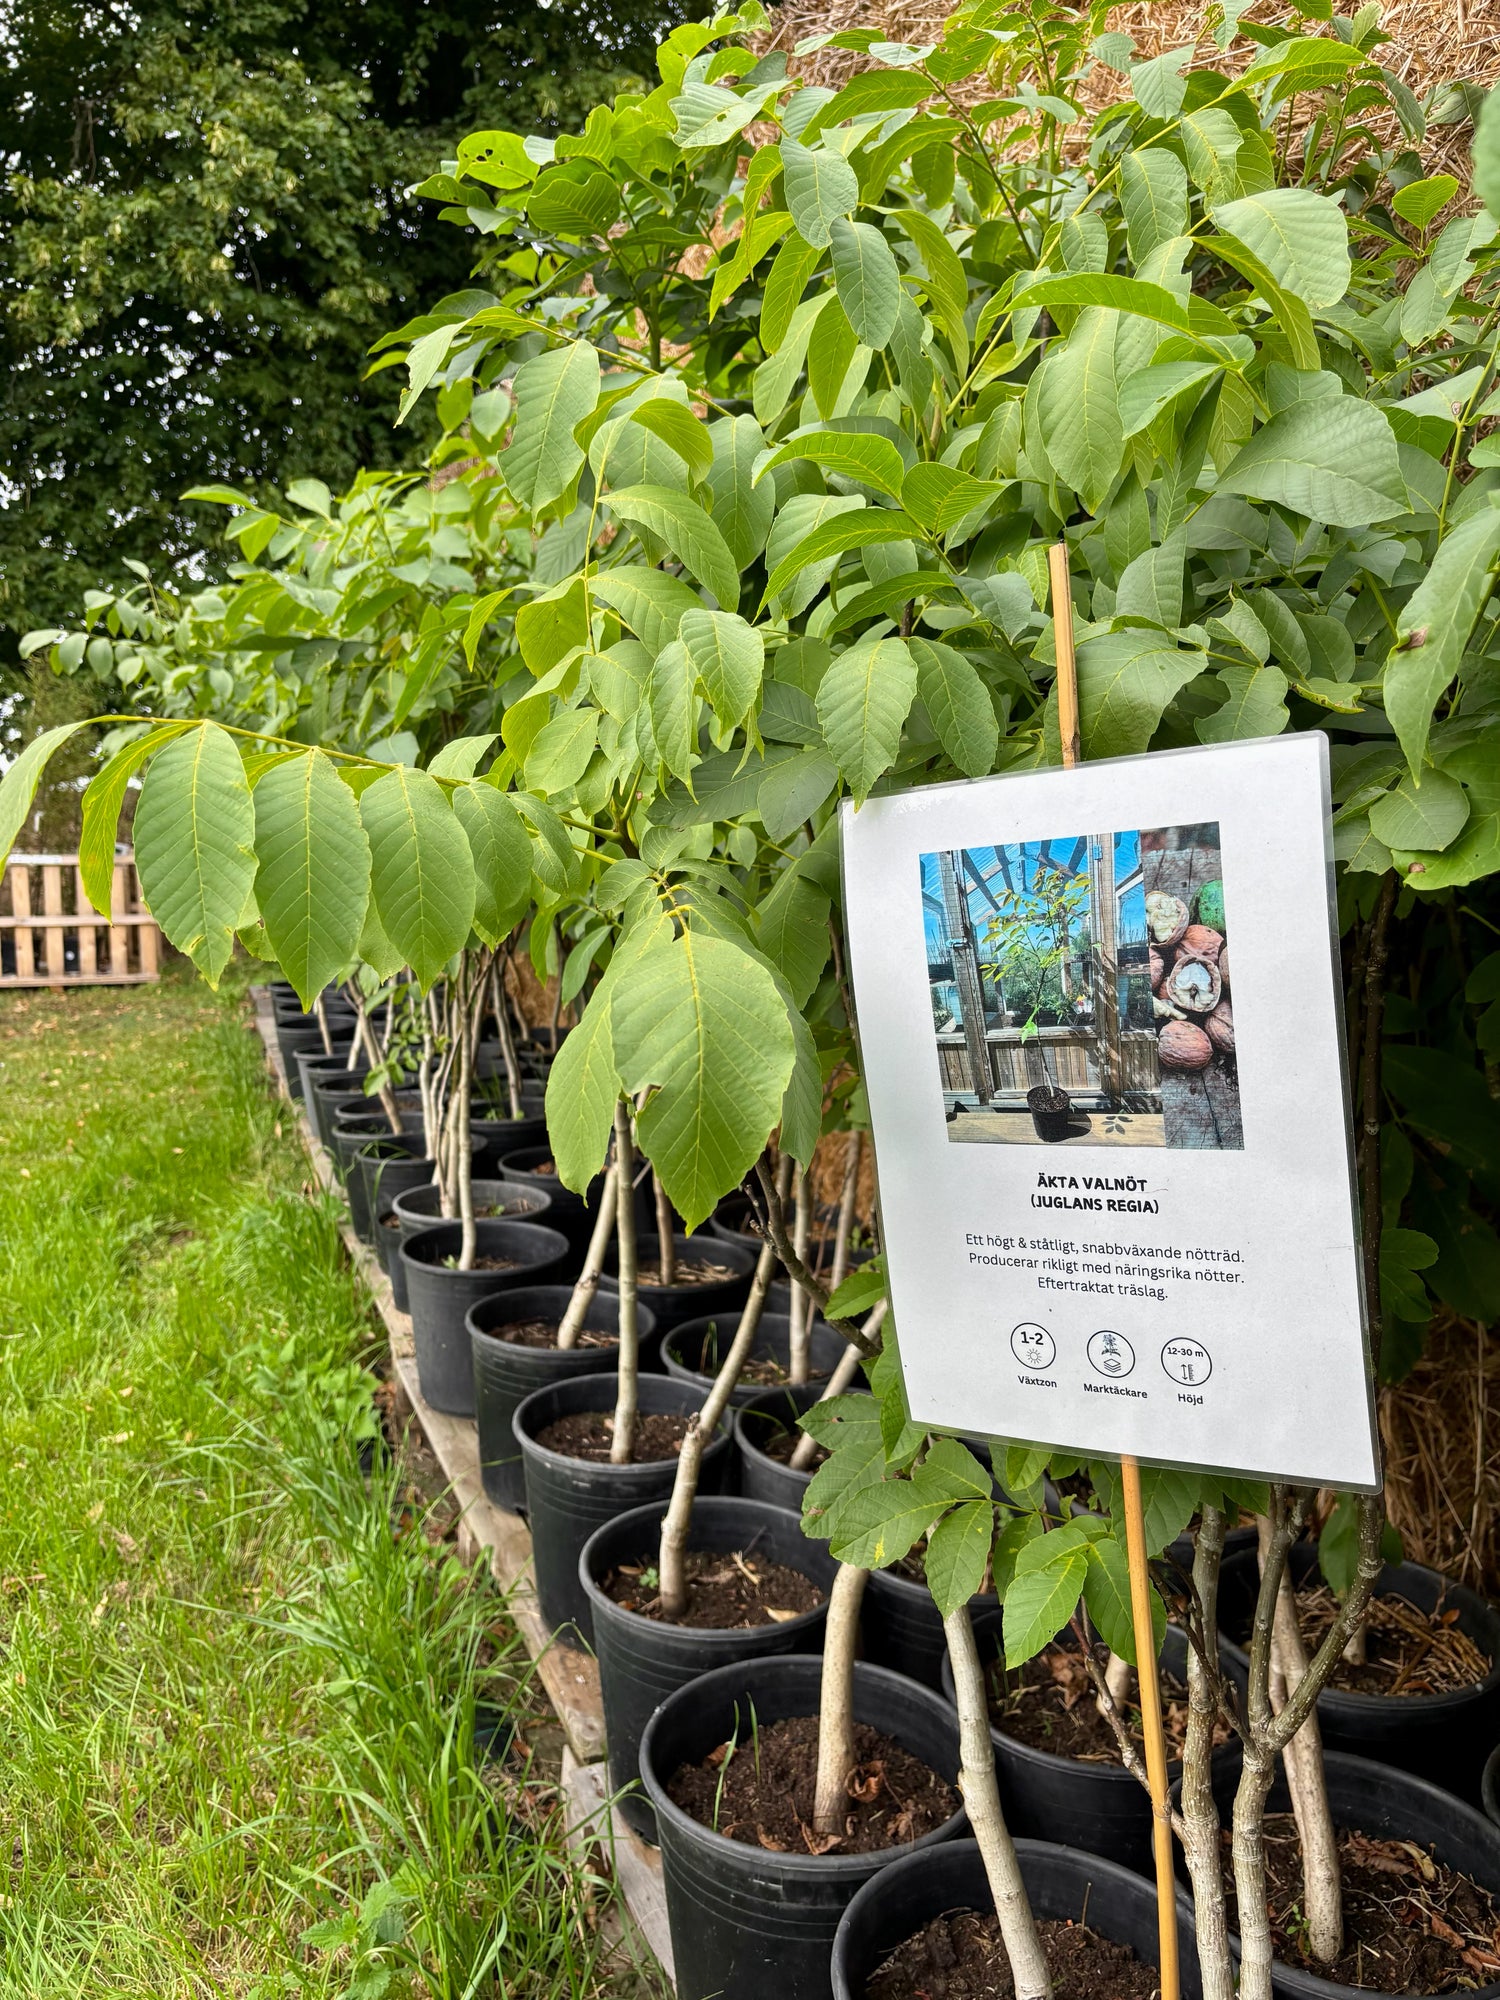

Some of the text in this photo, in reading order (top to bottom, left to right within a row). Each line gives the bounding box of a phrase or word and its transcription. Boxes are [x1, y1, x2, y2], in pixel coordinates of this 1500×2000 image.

[1037, 1171, 1148, 1193] ÄKTA VALNÖT
[1031, 1193, 1160, 1215] (JUGLANS REGIA)
[965, 1233, 1245, 1263] Ett högt & ståtligt, snabbväxande nötträd.
[969, 1252, 1245, 1284] Producerar rikligt med näringsrika nötter.
[1037, 1276, 1169, 1302] Eftertraktat träslag.
[1020, 1330, 1045, 1346] 1-2
[1166, 1346, 1204, 1358] 12-30 m
[1017, 1375, 1058, 1389] Växtzon
[1083, 1382, 1148, 1399] Marktäckare
[1177, 1392, 1204, 1407] Höjd
